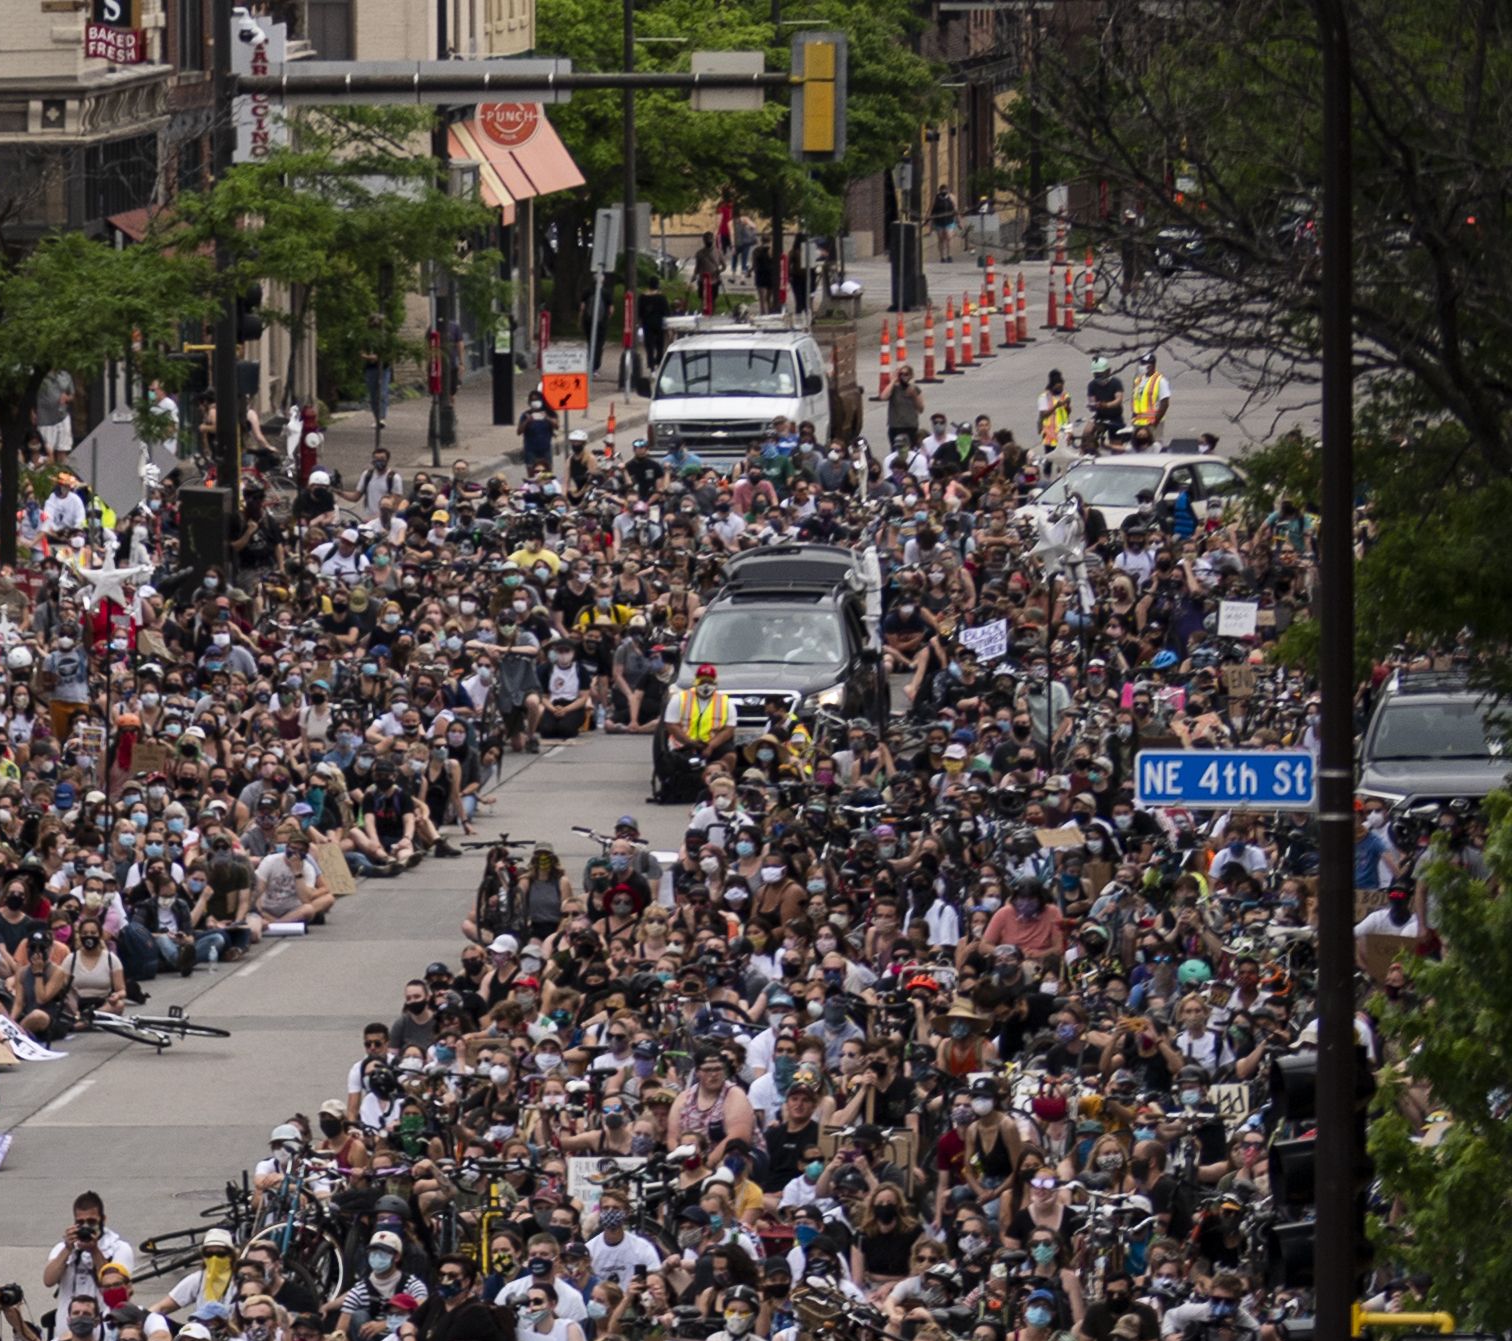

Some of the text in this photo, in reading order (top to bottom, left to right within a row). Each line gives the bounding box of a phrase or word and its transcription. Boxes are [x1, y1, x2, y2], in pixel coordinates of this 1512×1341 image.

[87, 26, 135, 49] BAKED
[87, 40, 136, 63] FRESH
[486, 109, 536, 124] PUNCH
[1143, 765, 1309, 796] NE 4th St
